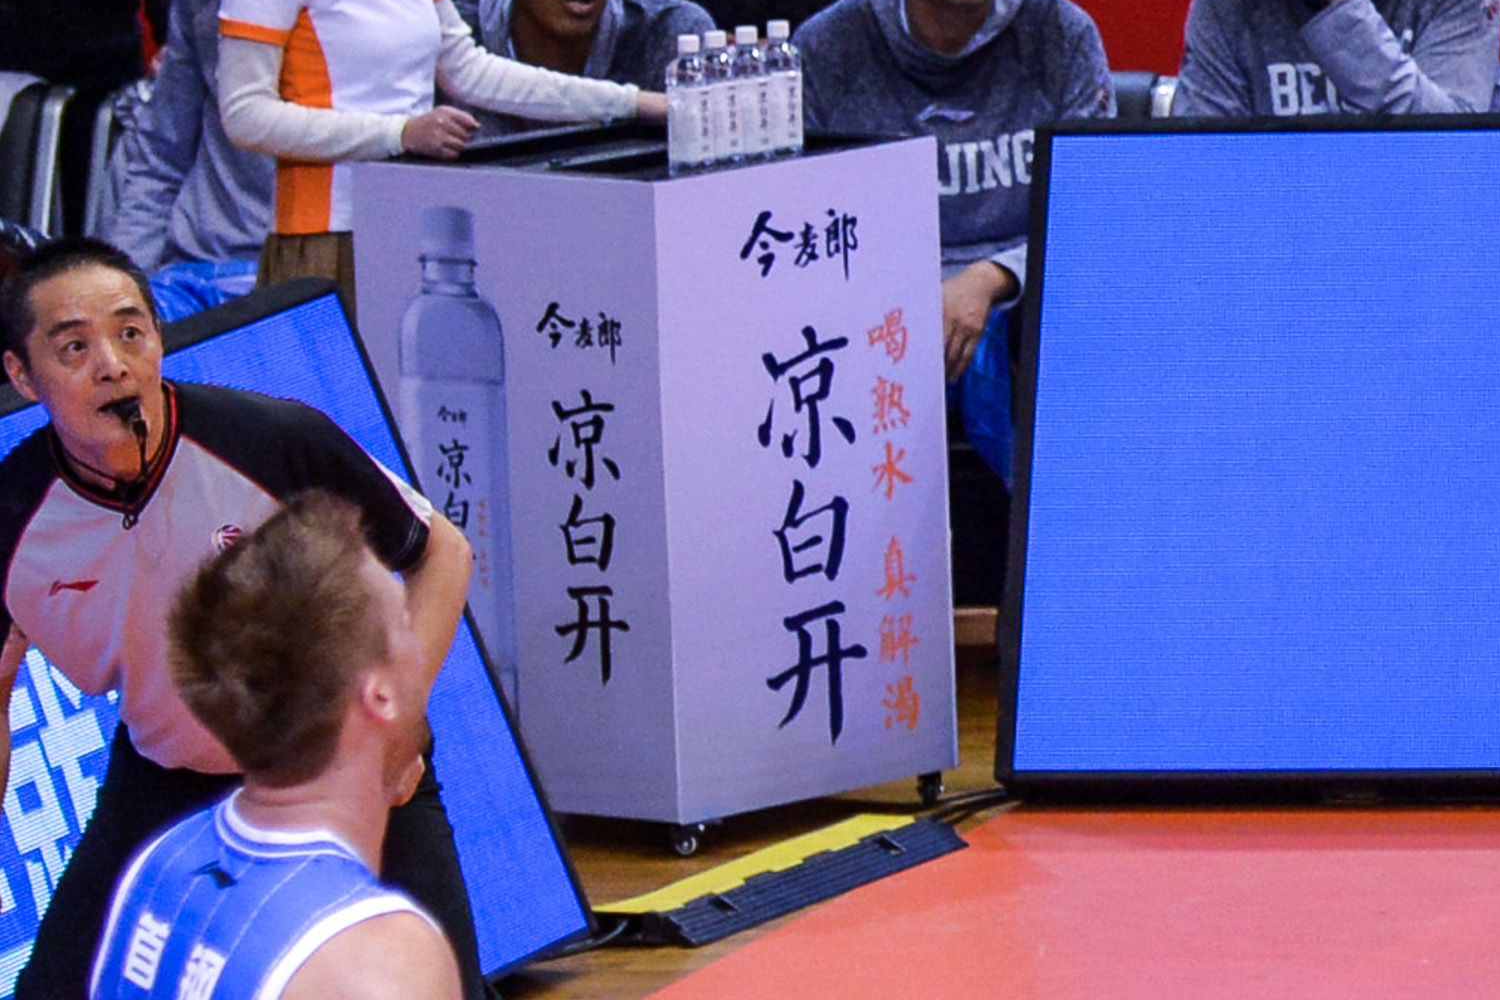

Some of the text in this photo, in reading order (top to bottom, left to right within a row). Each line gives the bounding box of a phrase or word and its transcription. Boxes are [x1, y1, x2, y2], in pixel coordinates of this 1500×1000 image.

[740, 209, 858, 281] 今麦郎
[536, 302, 622, 365] 今麦郎
[437, 439, 476, 560] 凉白
[548, 389, 630, 686] 凉白开
[757, 325, 868, 746] 凉白开
